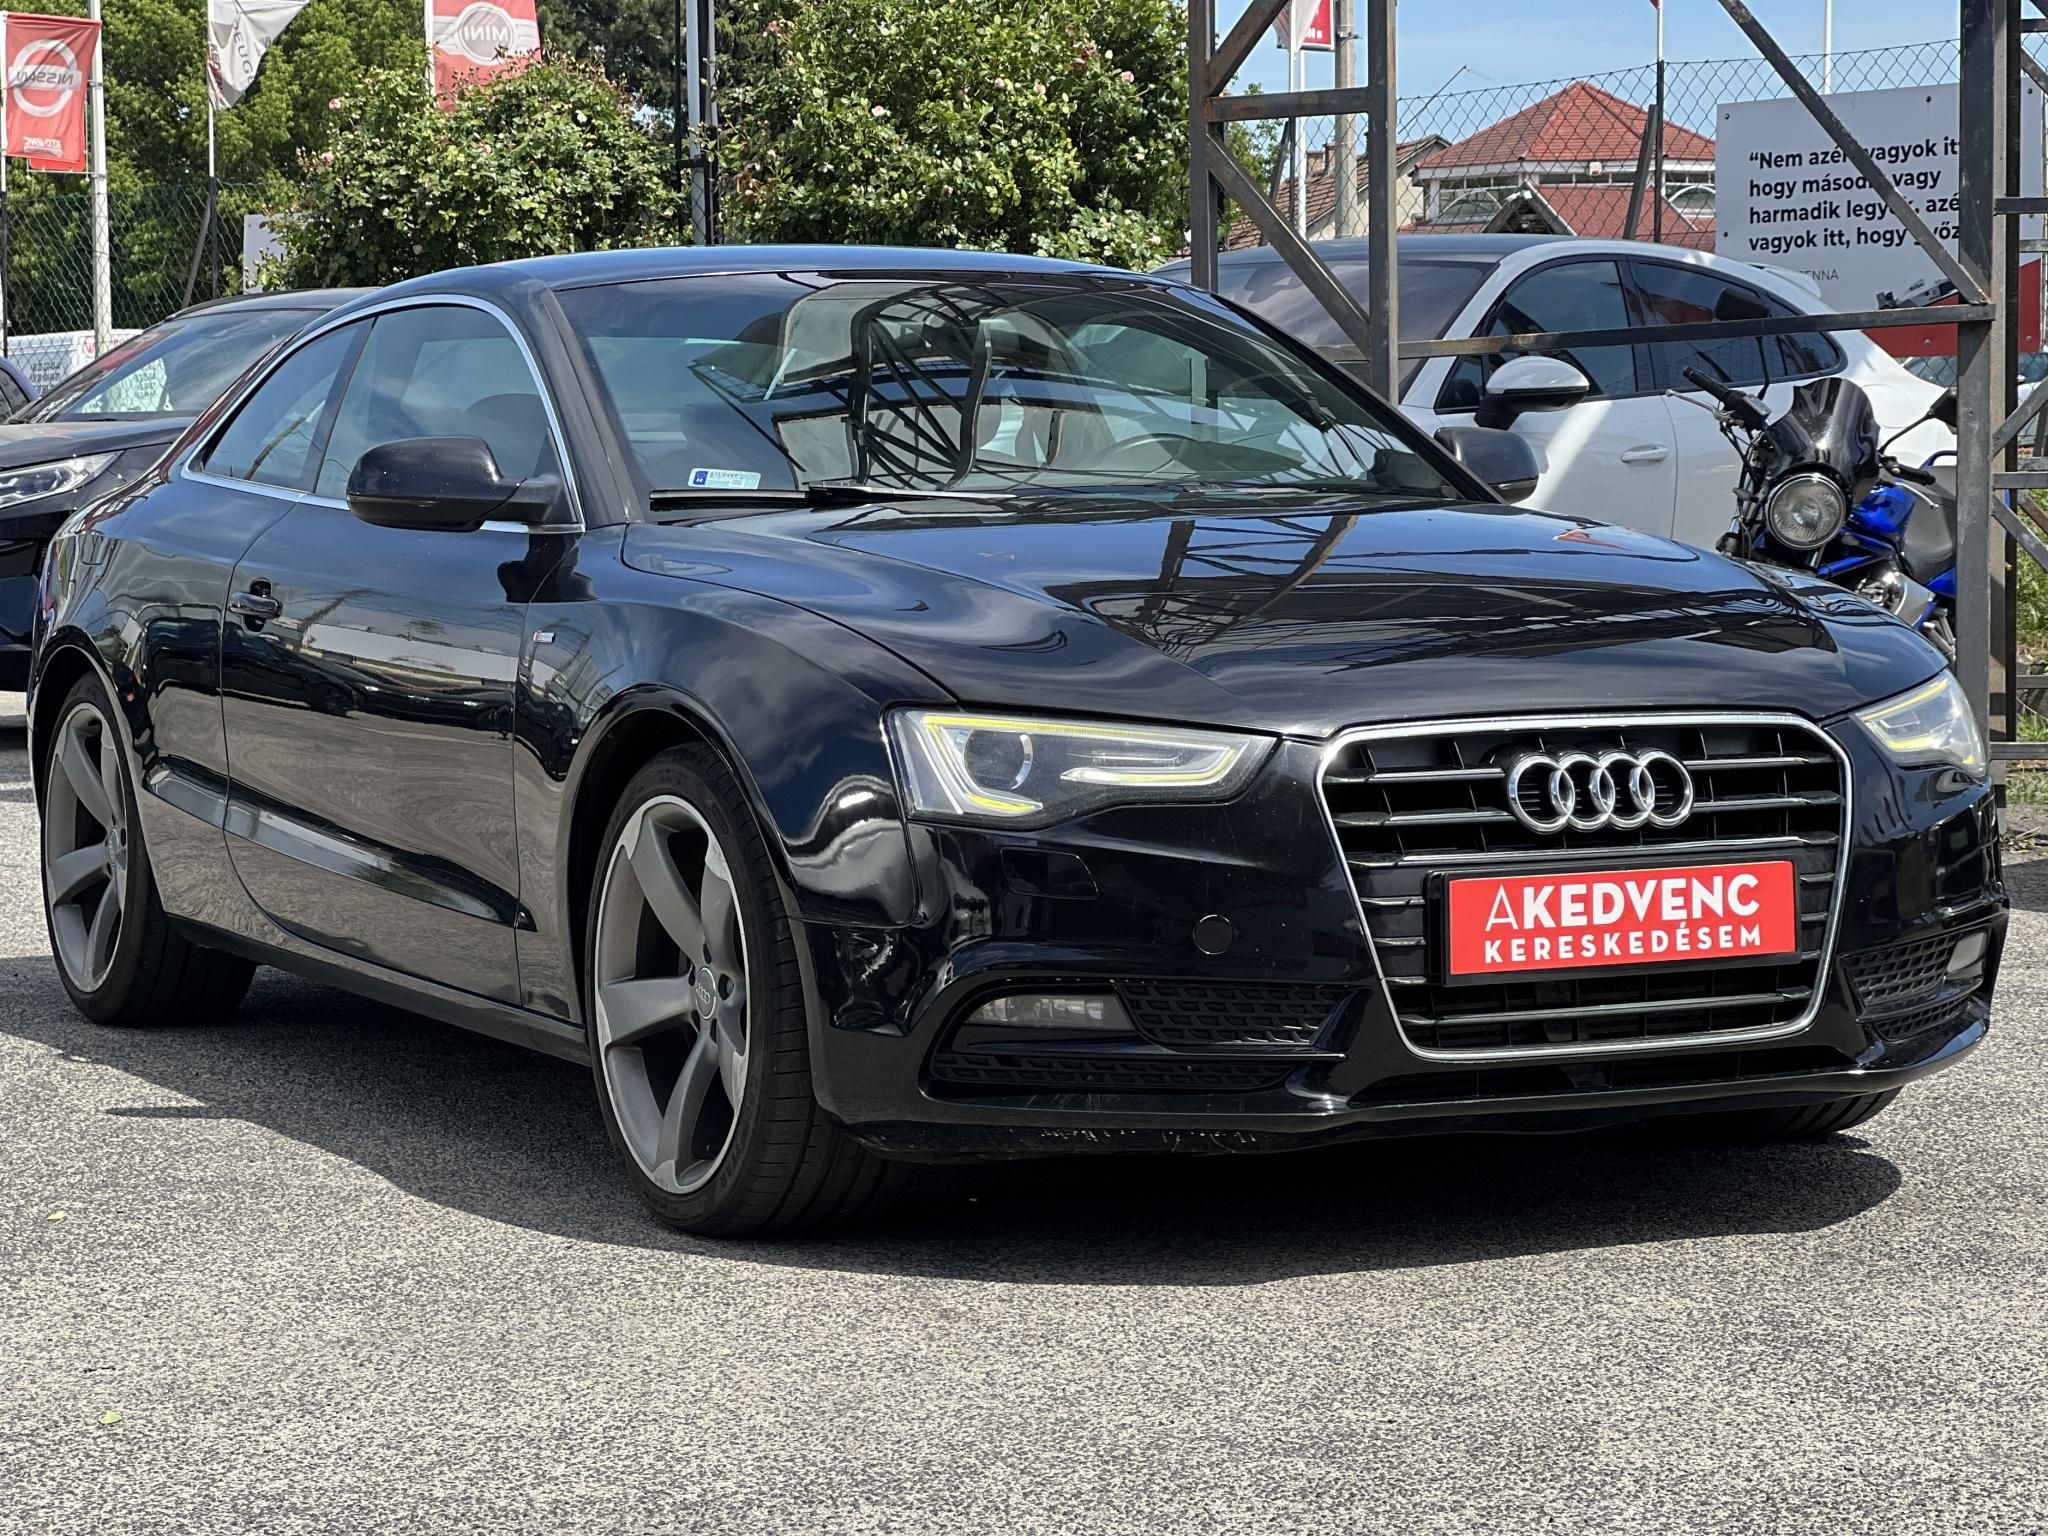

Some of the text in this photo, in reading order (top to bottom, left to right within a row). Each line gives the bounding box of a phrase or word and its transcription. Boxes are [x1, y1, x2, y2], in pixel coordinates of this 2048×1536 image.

[1943, 136, 1960, 156] it
[1749, 170, 1942, 200] hogy másod vagy
[1749, 200, 1841, 224] harmadik
[1926, 192, 1960, 213] azé
[1749, 230, 1818, 254] vagyok
[1823, 228, 1851, 249] itt,
[1857, 226, 1908, 247] hogy
[1799, 269, 1839, 281] NNA
[1484, 922, 1761, 964] KERESKEDÉSEM
